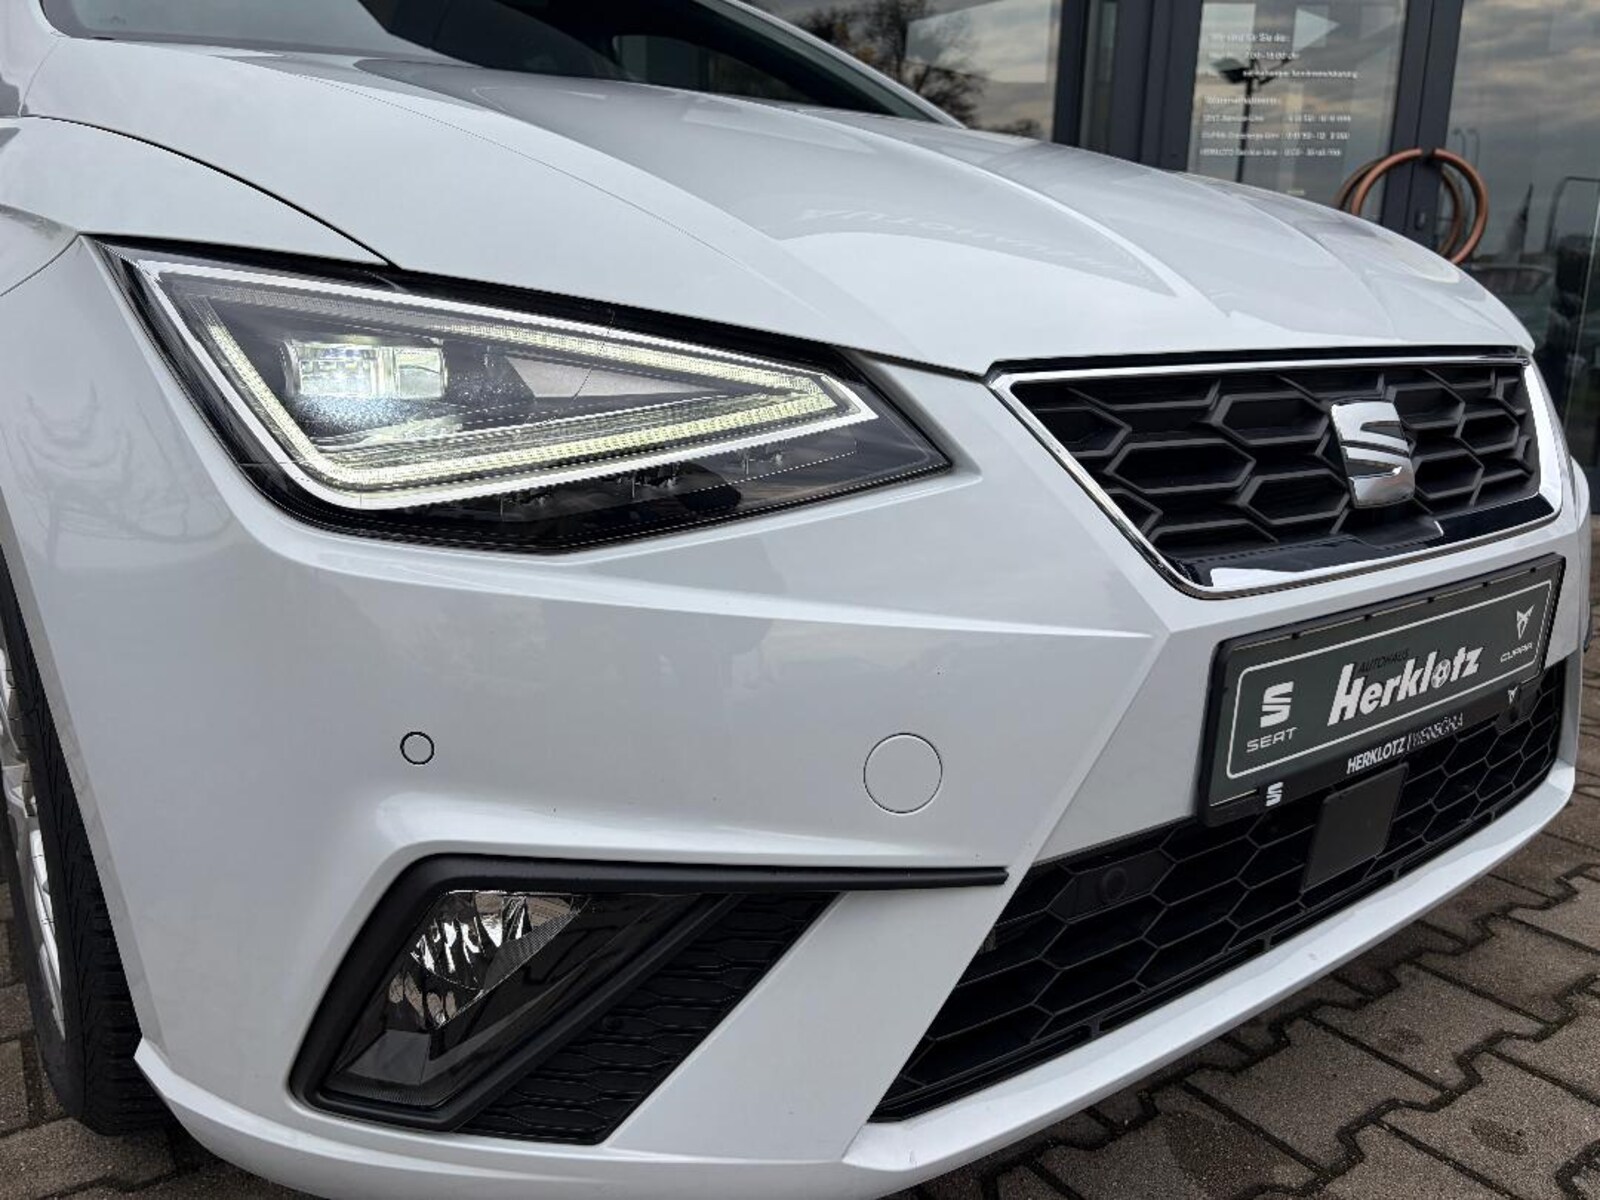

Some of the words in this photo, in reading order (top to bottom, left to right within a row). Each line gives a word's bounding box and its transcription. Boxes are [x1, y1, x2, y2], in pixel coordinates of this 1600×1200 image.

[1327, 646, 1484, 727] Herklotz
[1246, 726, 1298, 753] SEAT
[1346, 735, 1407, 775] HERKLOTZ
